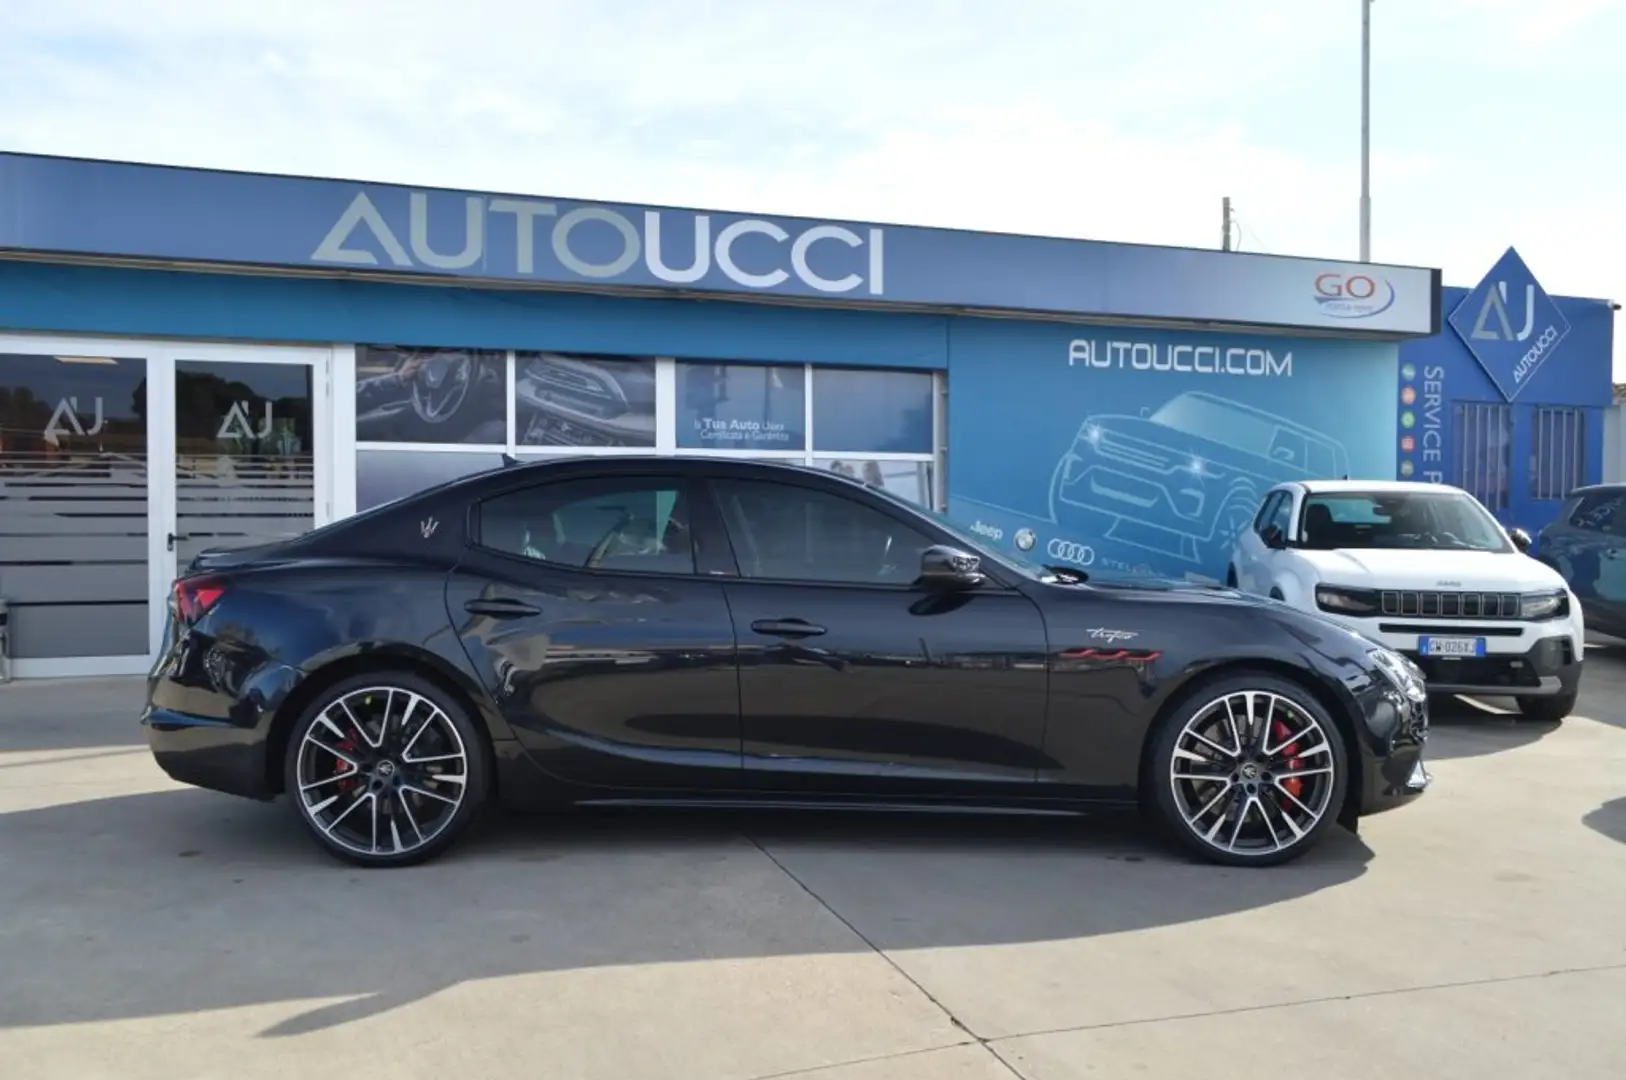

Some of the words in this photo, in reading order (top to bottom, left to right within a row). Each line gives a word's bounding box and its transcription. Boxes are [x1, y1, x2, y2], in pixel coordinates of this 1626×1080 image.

[310, 191, 883, 294] AUTOUCCI
[1315, 273, 1376, 298] GO
[1069, 339, 1292, 376] AUTOUCCI.COM
[1513, 325, 1558, 383] AUTOUCCI
[730, 420, 760, 431] Auto
[1423, 365, 1444, 461] SERVICE
[1422, 471, 1443, 483] P
[970, 520, 1003, 541] Jeep
